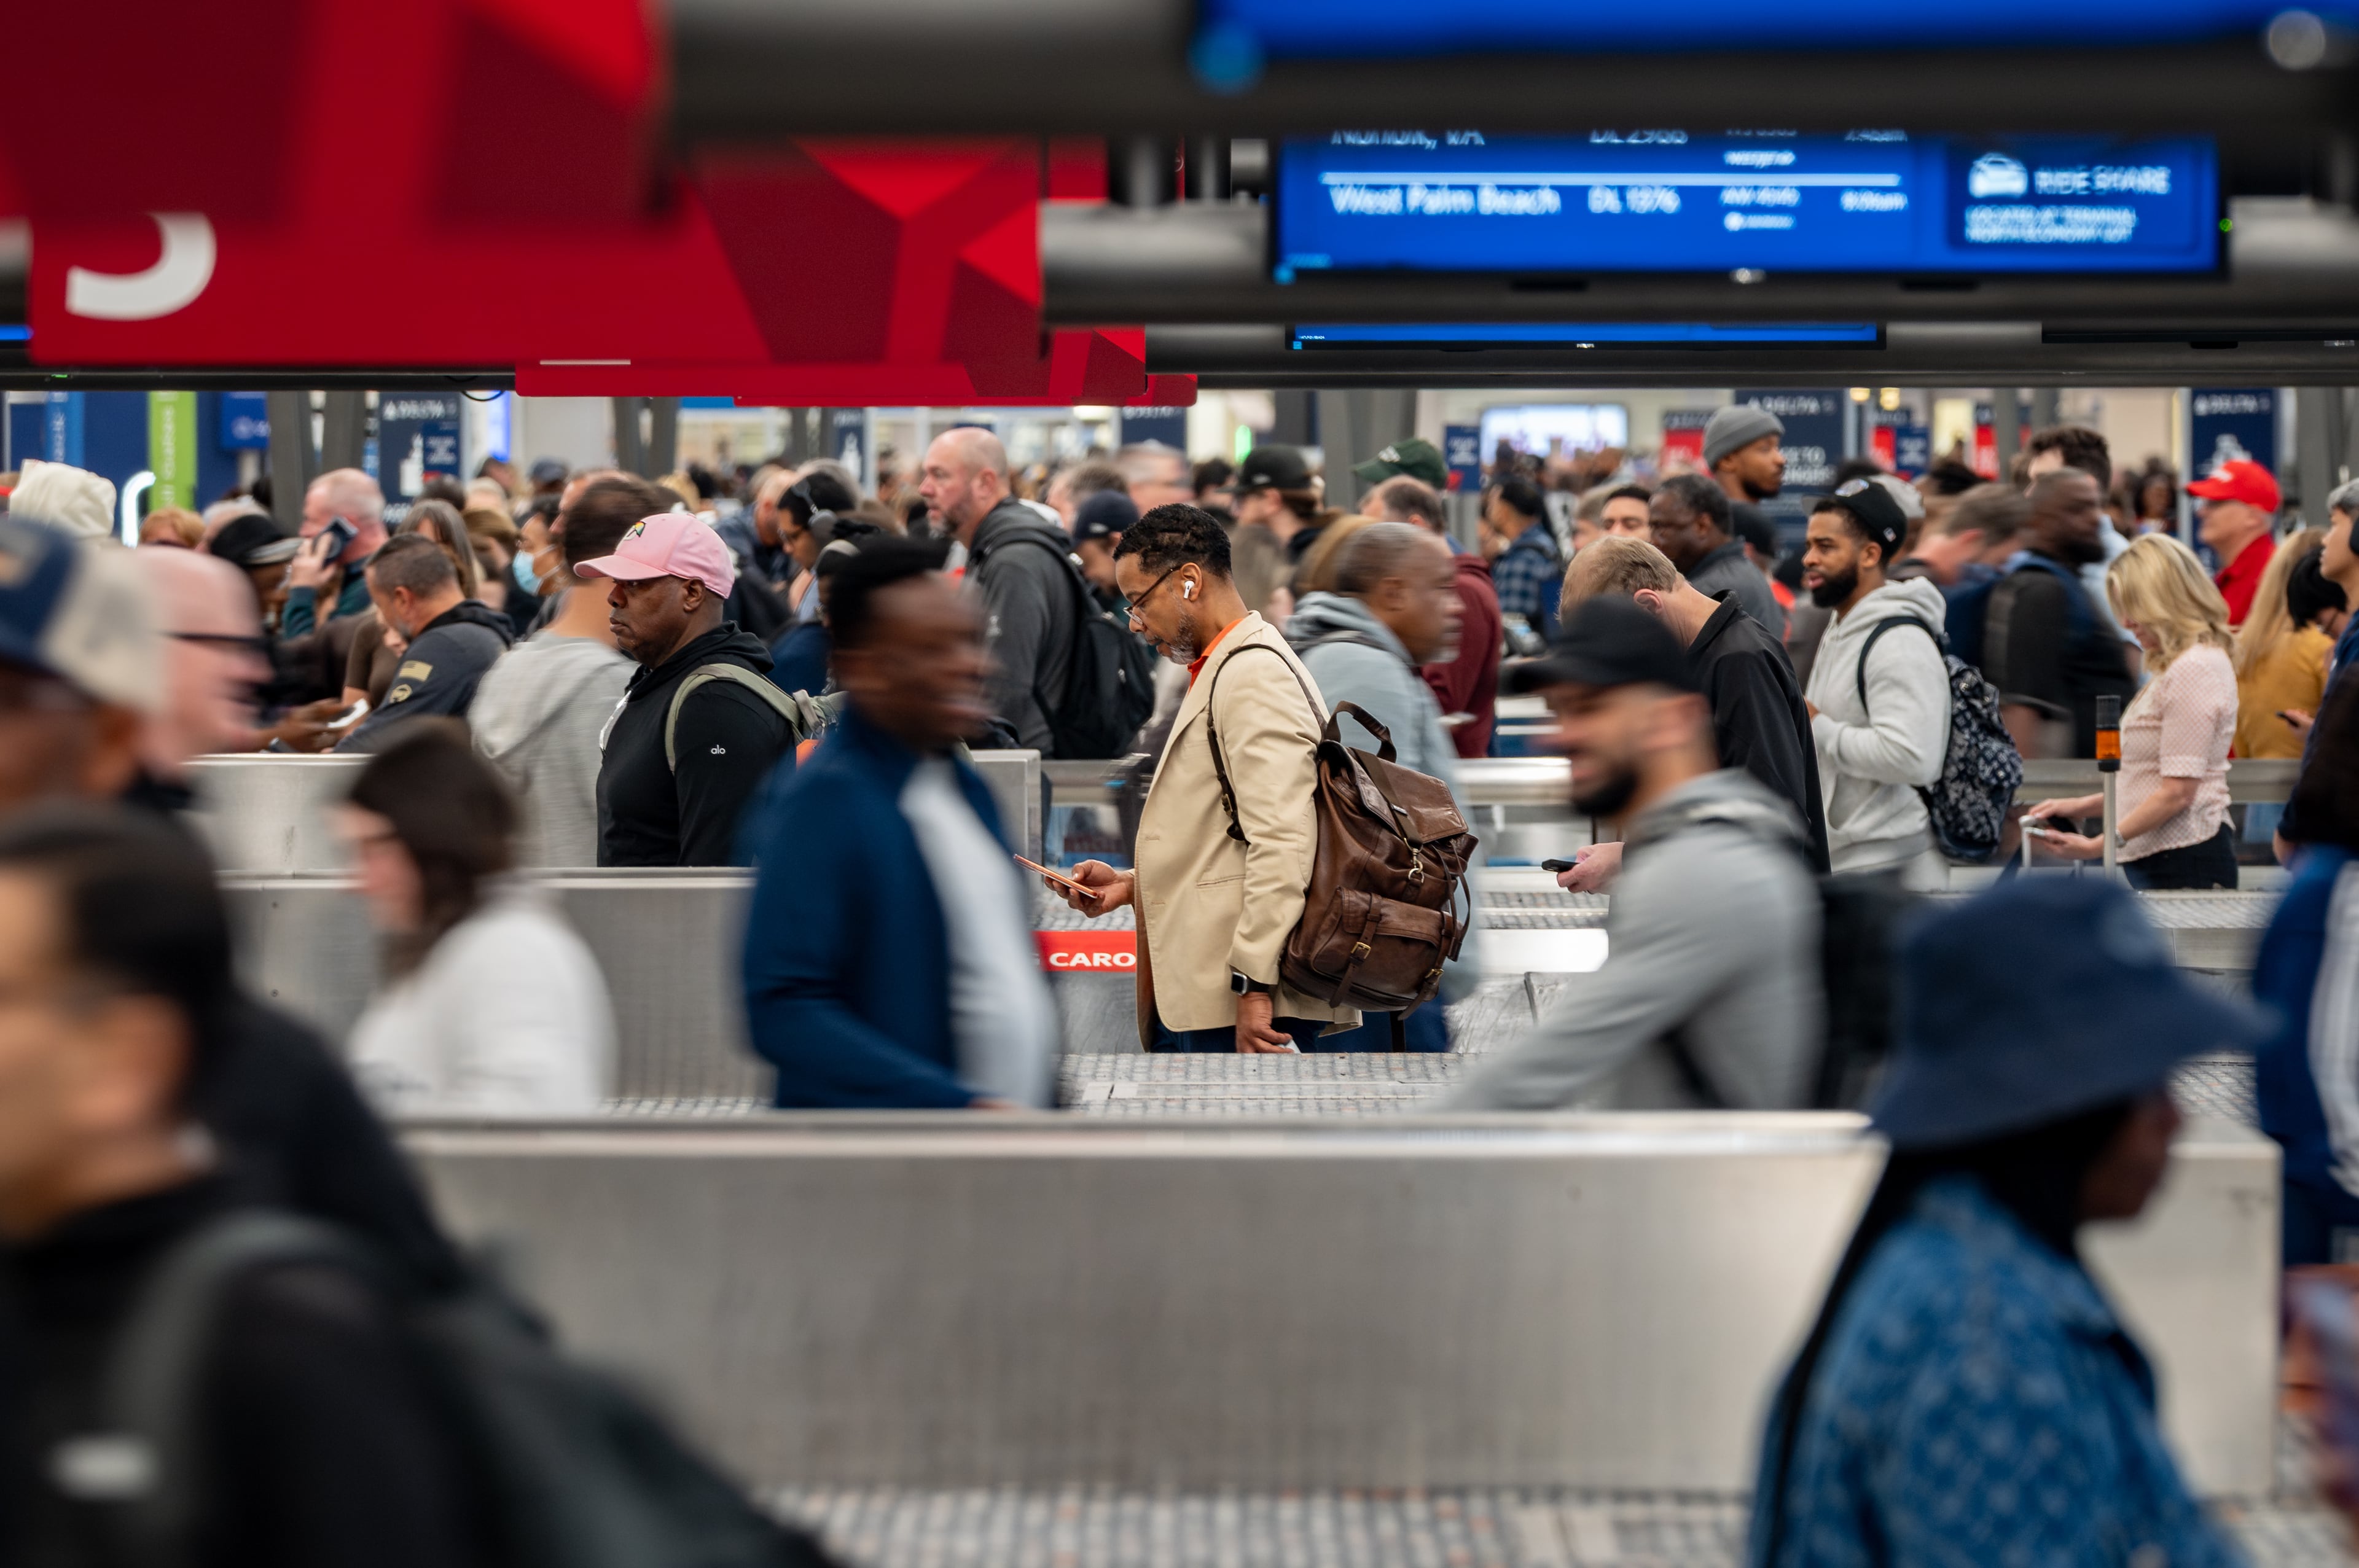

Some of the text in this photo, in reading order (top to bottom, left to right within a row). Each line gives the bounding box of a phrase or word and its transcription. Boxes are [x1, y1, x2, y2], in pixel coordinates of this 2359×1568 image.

[2093, 166, 2171, 195] SHARE
[1329, 185, 1403, 214] West
[1406, 184, 1474, 214] Palm
[1477, 184, 1562, 214] Beach
[711, 744, 726, 754] alo
[1049, 952, 1136, 967] CARO
